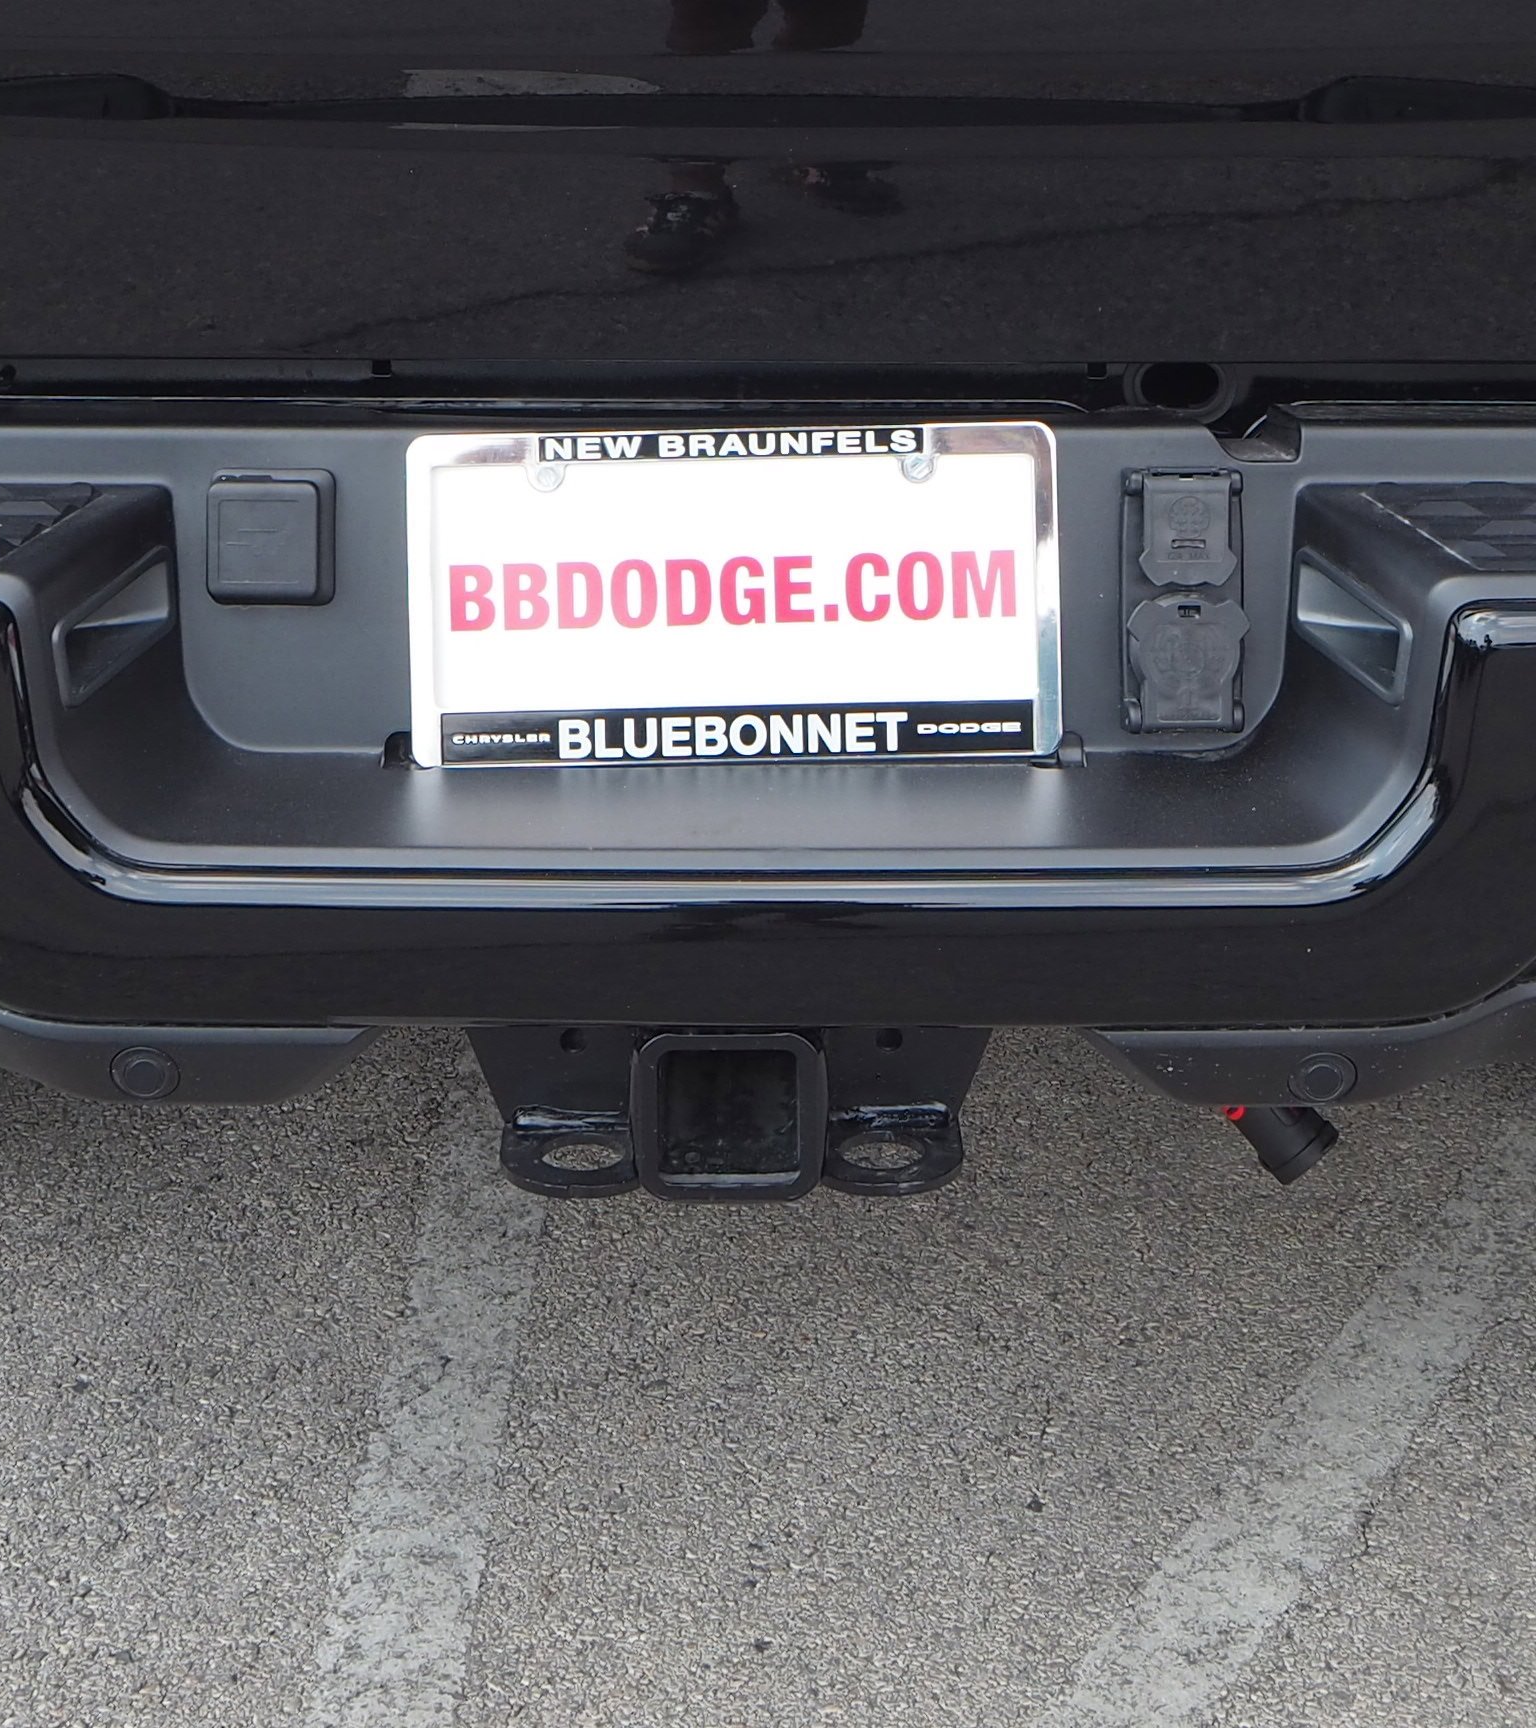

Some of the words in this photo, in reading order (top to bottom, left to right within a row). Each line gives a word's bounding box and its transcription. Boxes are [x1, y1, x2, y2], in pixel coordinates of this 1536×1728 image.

[544, 436, 642, 462] NEW
[657, 428, 918, 458] BRAUNFELS
[448, 549, 1017, 632] BBDODGE.COM
[452, 733, 551, 745] CHRYSLER
[557, 712, 909, 760] BLUEBONNET
[916, 721, 1022, 735] DODGE
